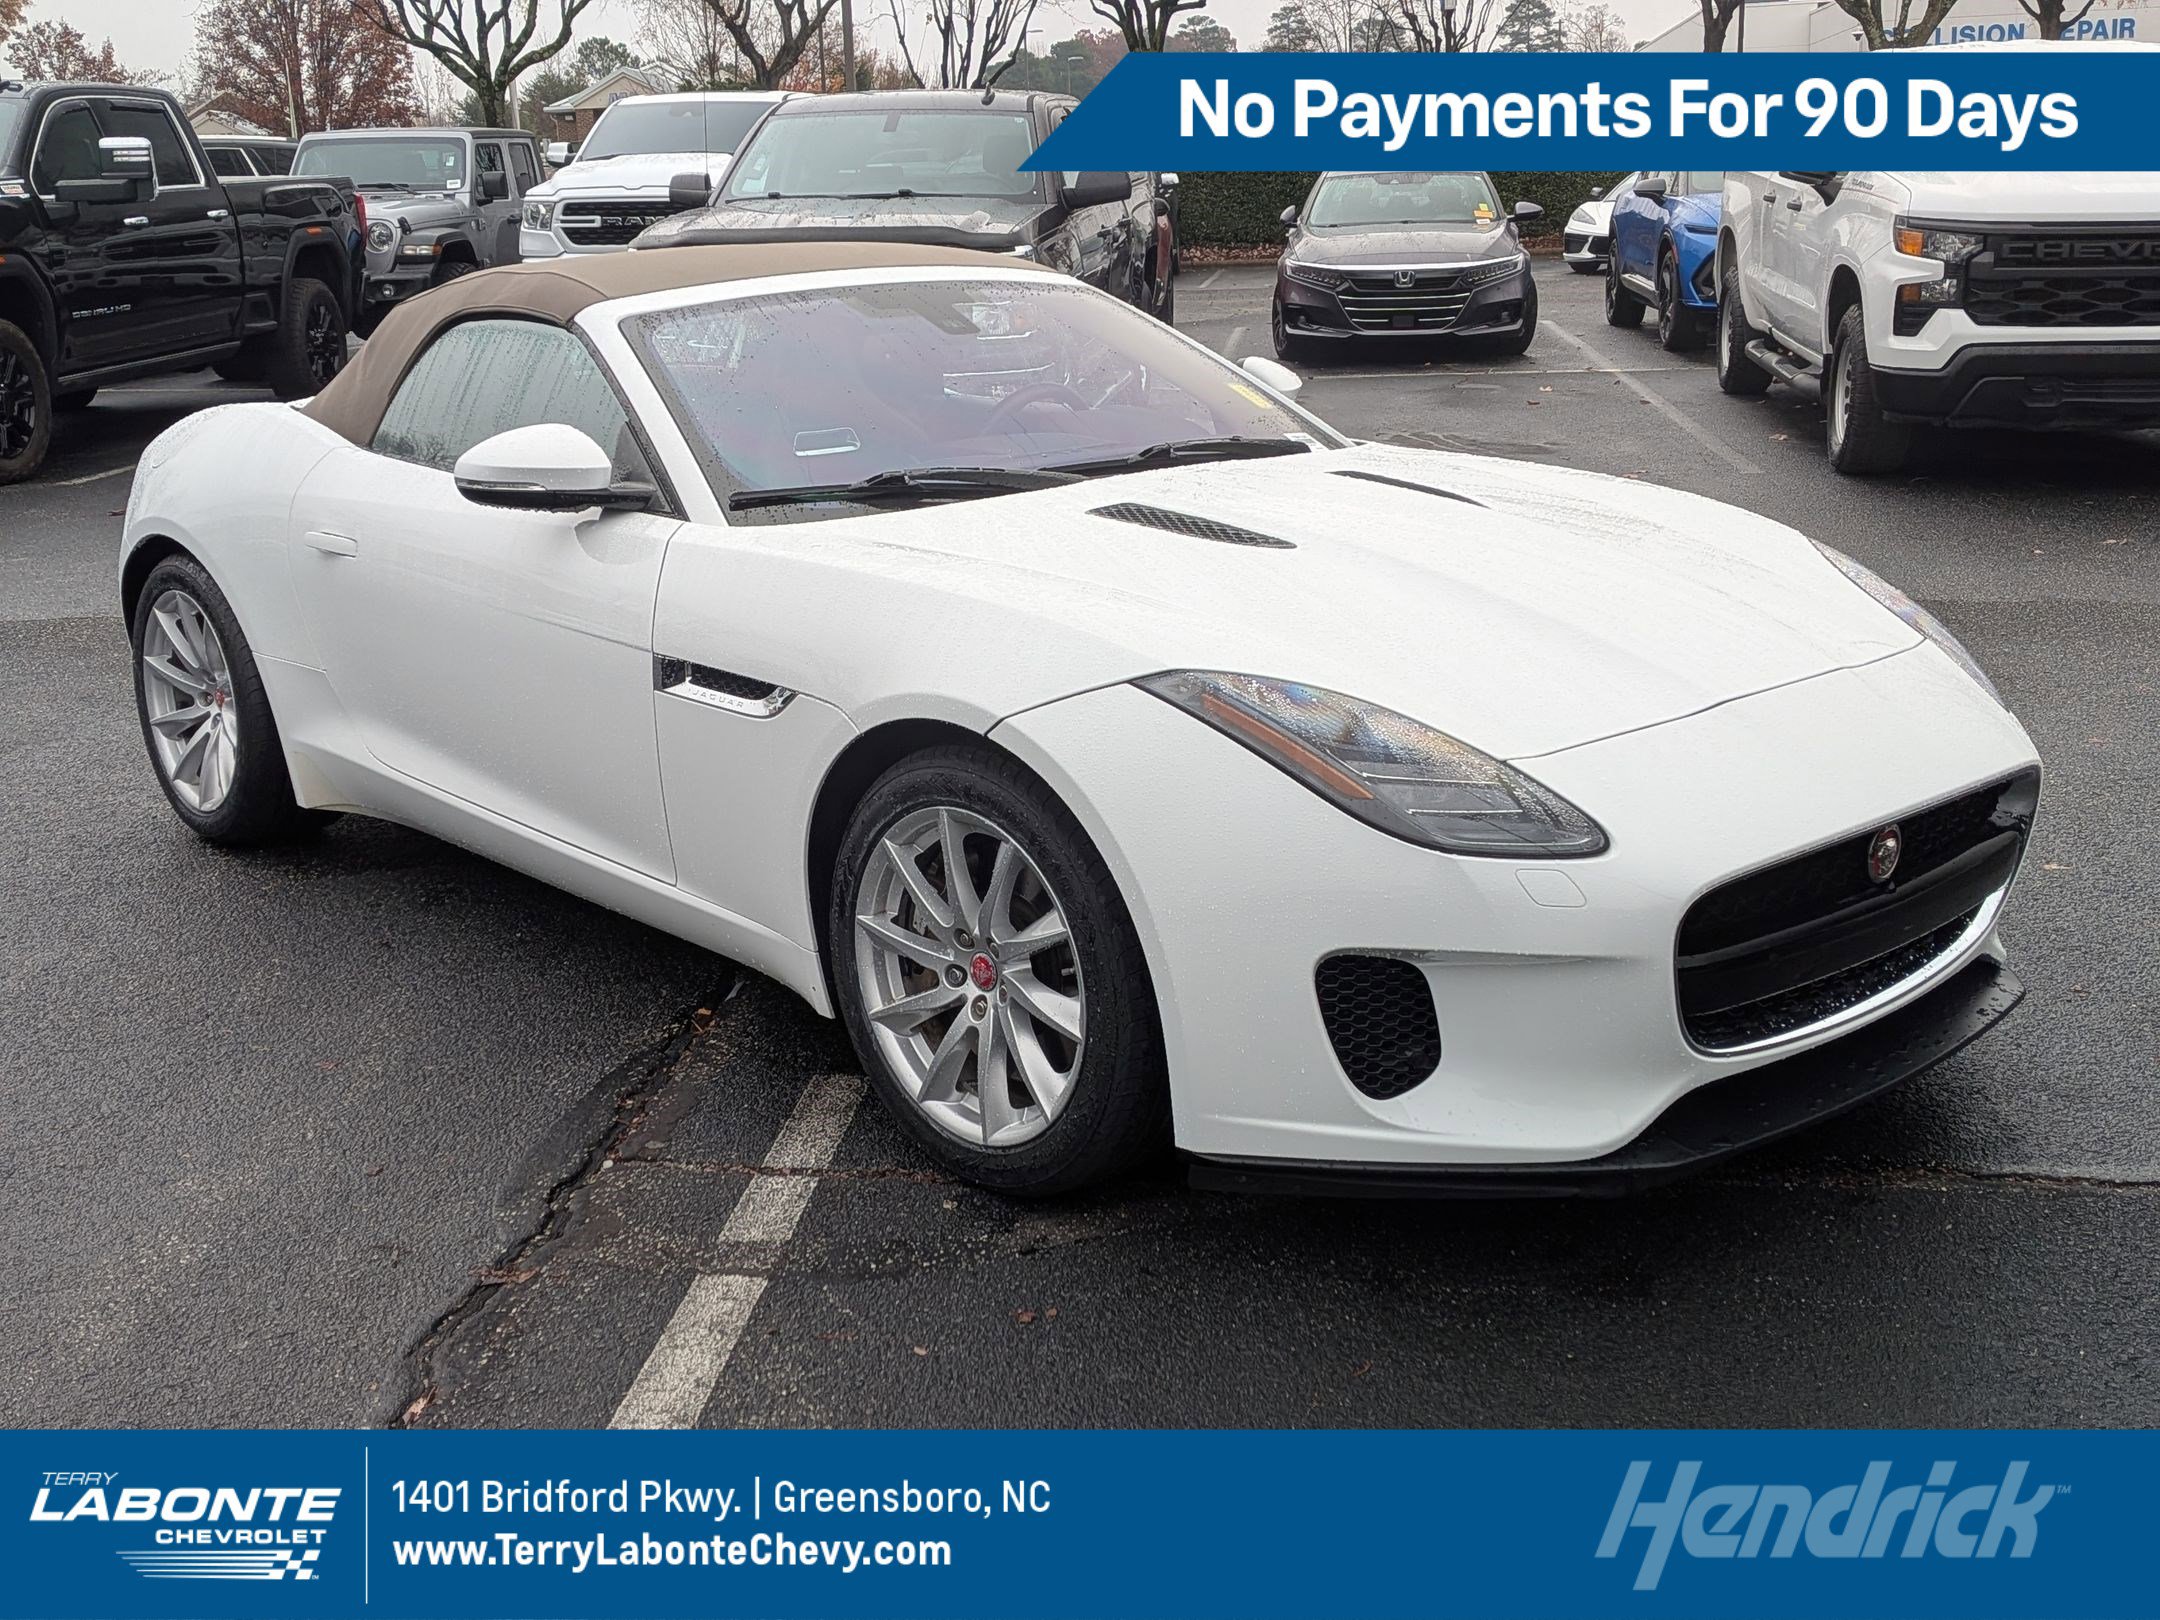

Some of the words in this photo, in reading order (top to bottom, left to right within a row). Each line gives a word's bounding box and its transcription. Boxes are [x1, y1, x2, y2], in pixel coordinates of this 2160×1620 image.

[1884, 23, 2025, 46] LISION
[2061, 18, 2136, 41] EPAIR
[692, 689, 744, 708] JAGUAR
